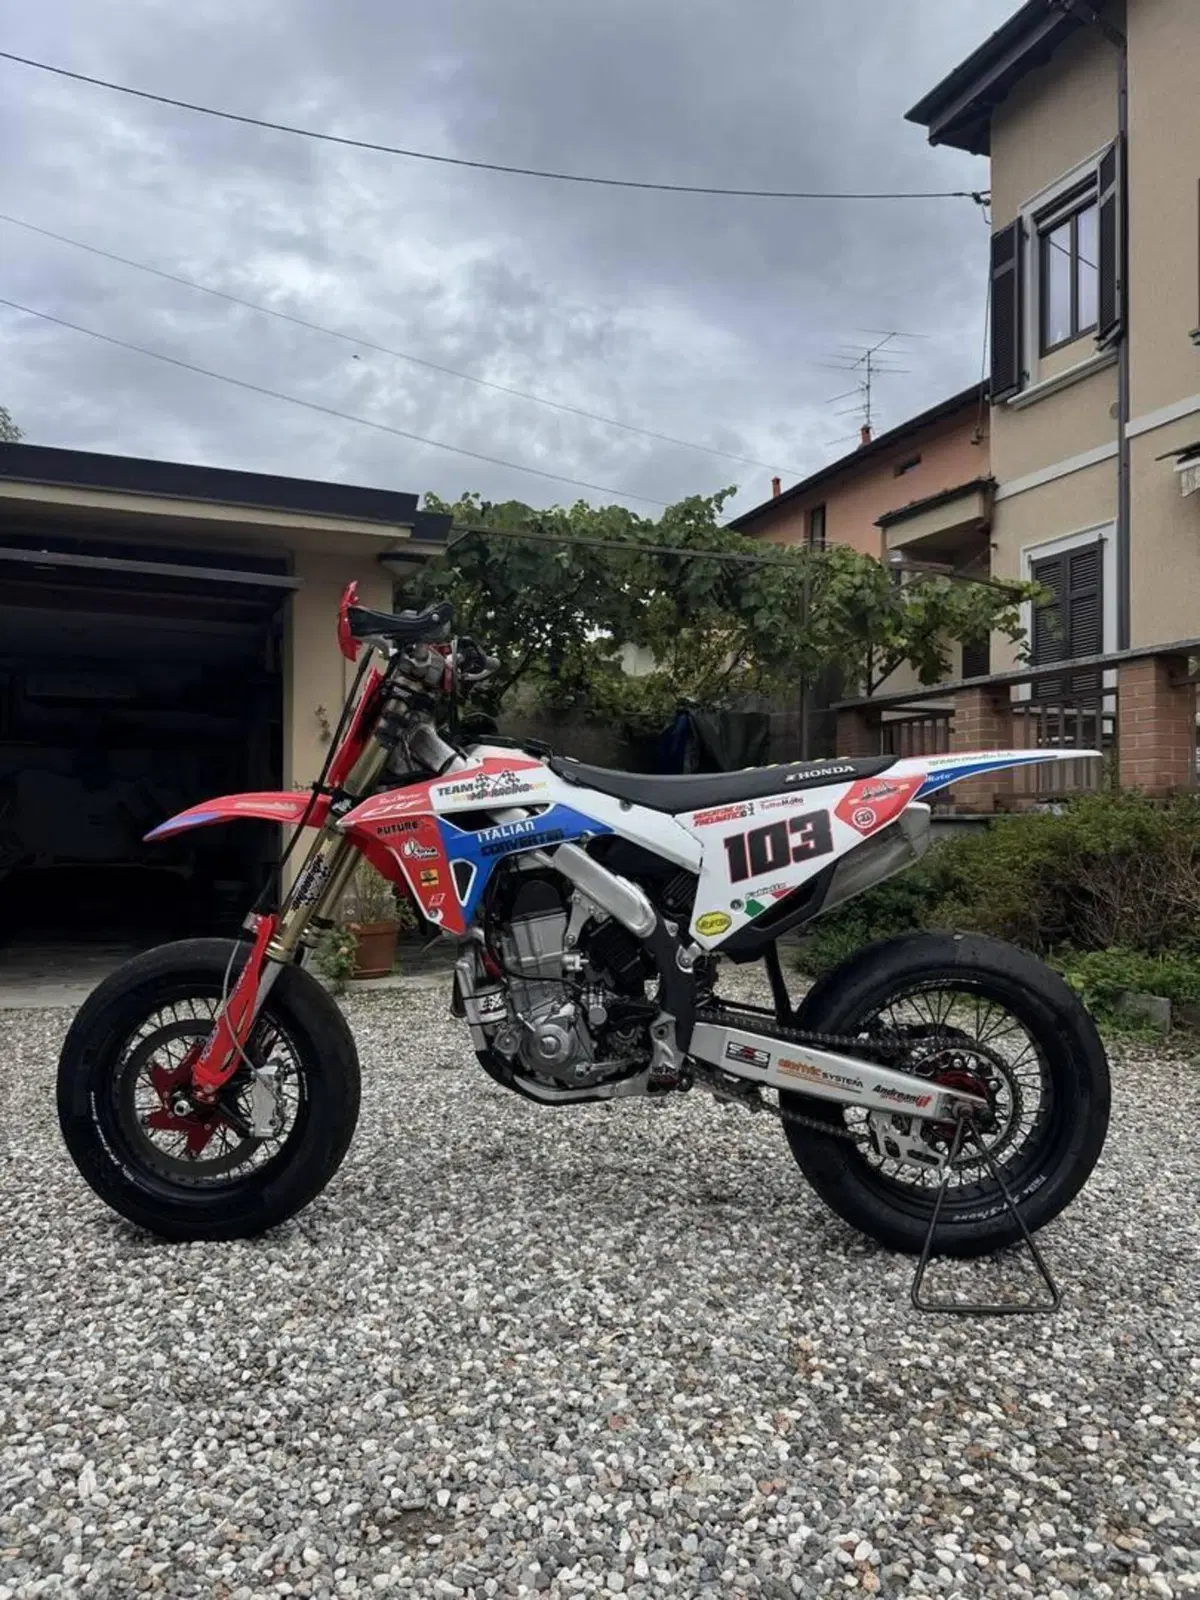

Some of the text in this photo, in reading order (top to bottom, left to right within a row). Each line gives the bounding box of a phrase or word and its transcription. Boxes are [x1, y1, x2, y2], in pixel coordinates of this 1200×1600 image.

[798, 765, 856, 780] HONDA
[437, 783, 474, 797] TEAM
[377, 821, 419, 835] FUTURE
[723, 809, 834, 884] 103
